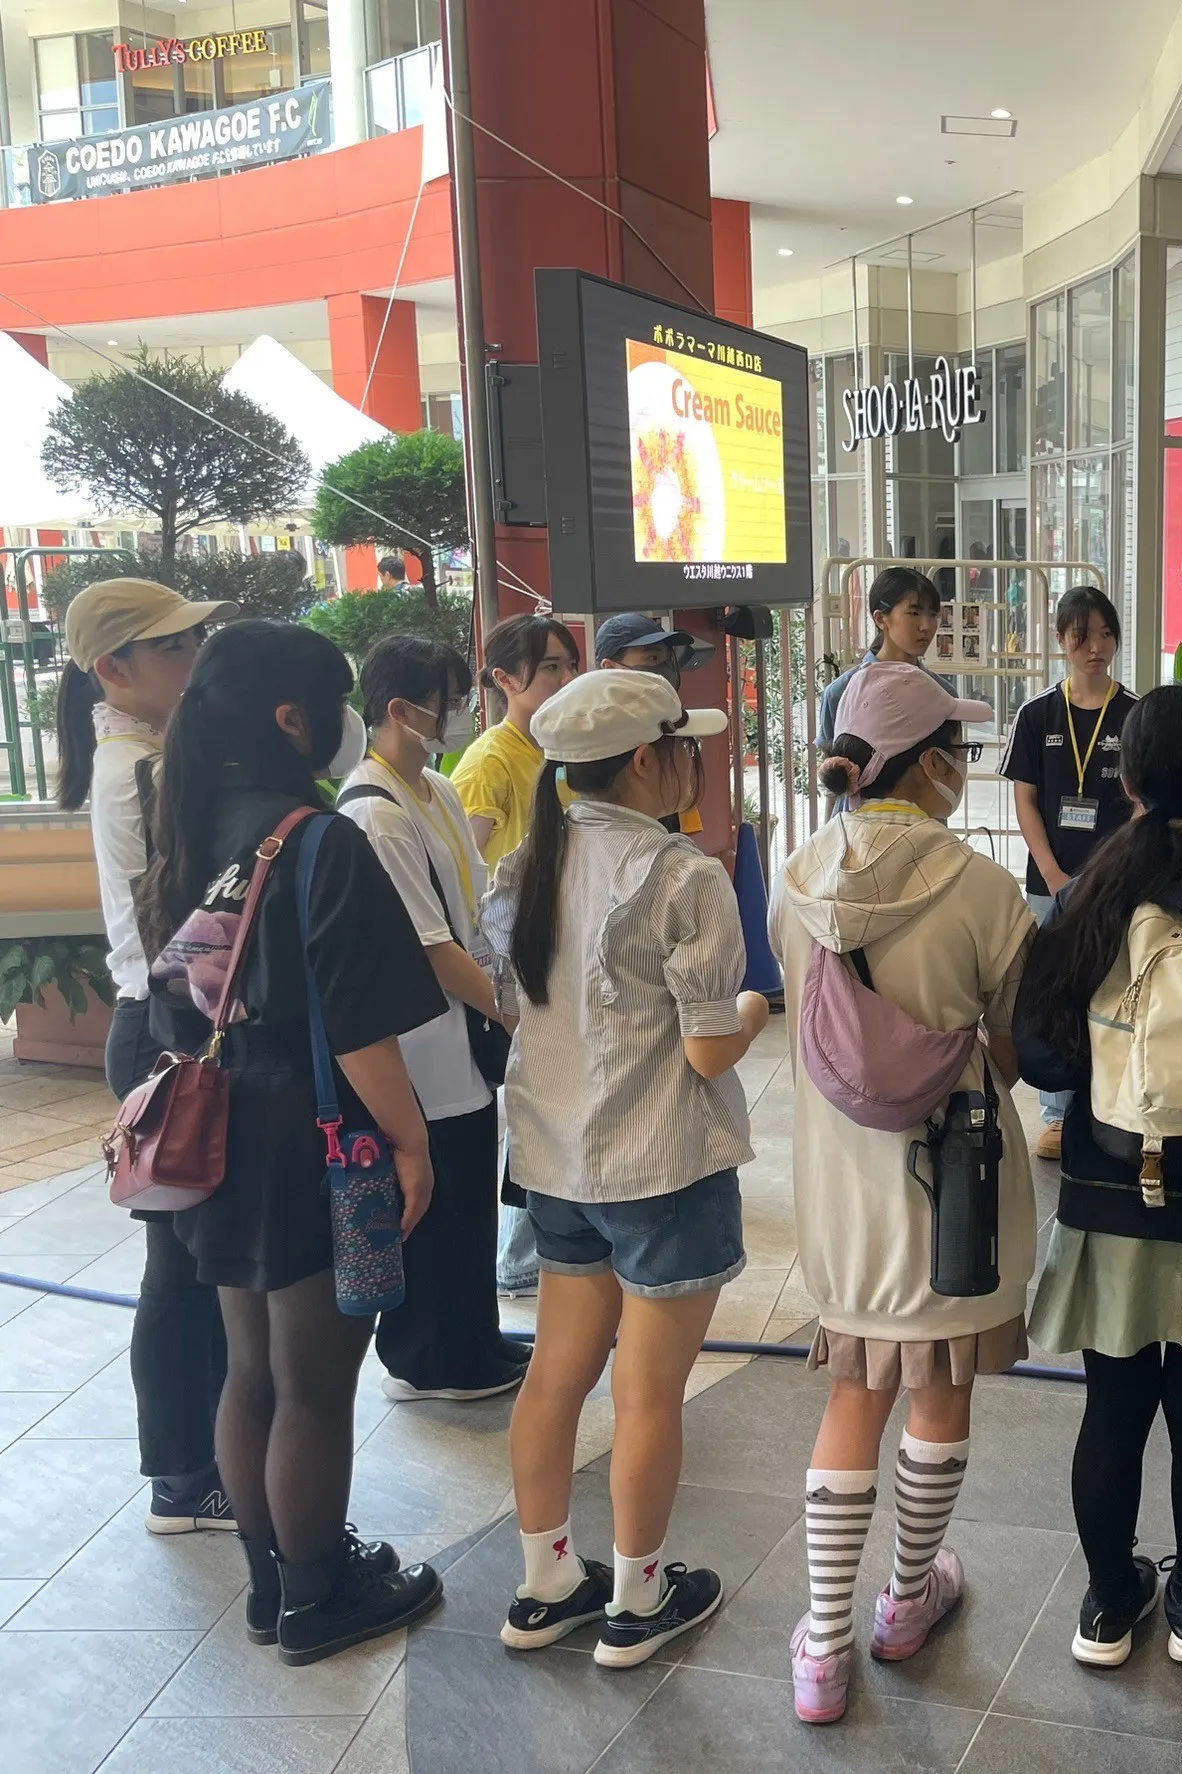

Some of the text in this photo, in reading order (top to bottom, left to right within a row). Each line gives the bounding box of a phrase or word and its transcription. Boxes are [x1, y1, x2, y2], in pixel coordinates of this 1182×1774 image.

[189, 30, 268, 62] COFFEE
[66, 135, 143, 174] COEDO
[149, 107, 261, 160] KAWAGOE
[671, 378, 781, 437] Cream Sauce
